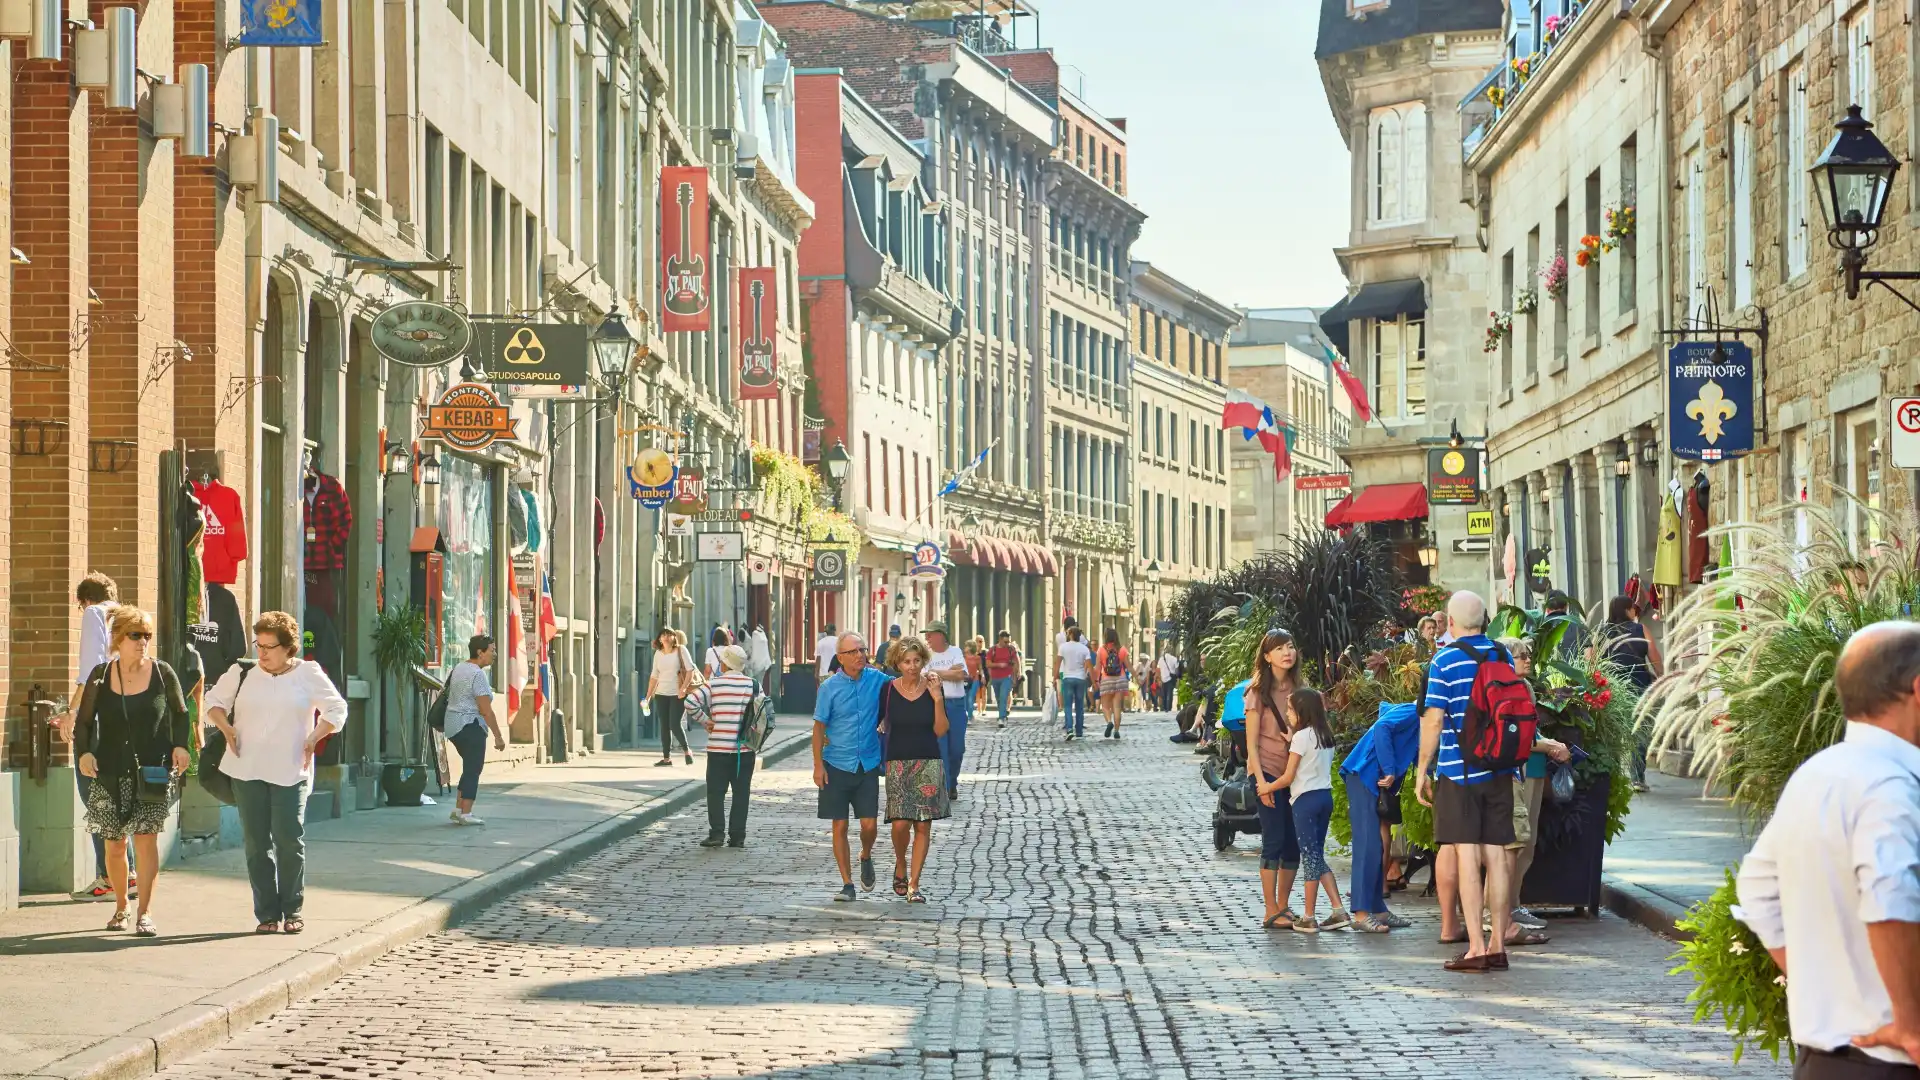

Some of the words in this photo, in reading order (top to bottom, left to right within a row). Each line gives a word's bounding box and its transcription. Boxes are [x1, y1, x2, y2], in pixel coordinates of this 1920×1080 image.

[668, 275, 680, 301] ST.
[682, 275, 704, 302] PAUL
[755, 354, 773, 375] PAUL
[1675, 365, 1746, 378] PATRIOTE
[487, 371, 561, 380] STUDIOSAPOLLO
[444, 387, 495, 405] MONTREAL
[443, 410, 494, 426] KEBAB
[633, 487, 671, 499] Amber
[683, 480, 704, 503] PAUL
[1470, 517, 1490, 529] ATM
[195, 633, 218, 643] ntréal
